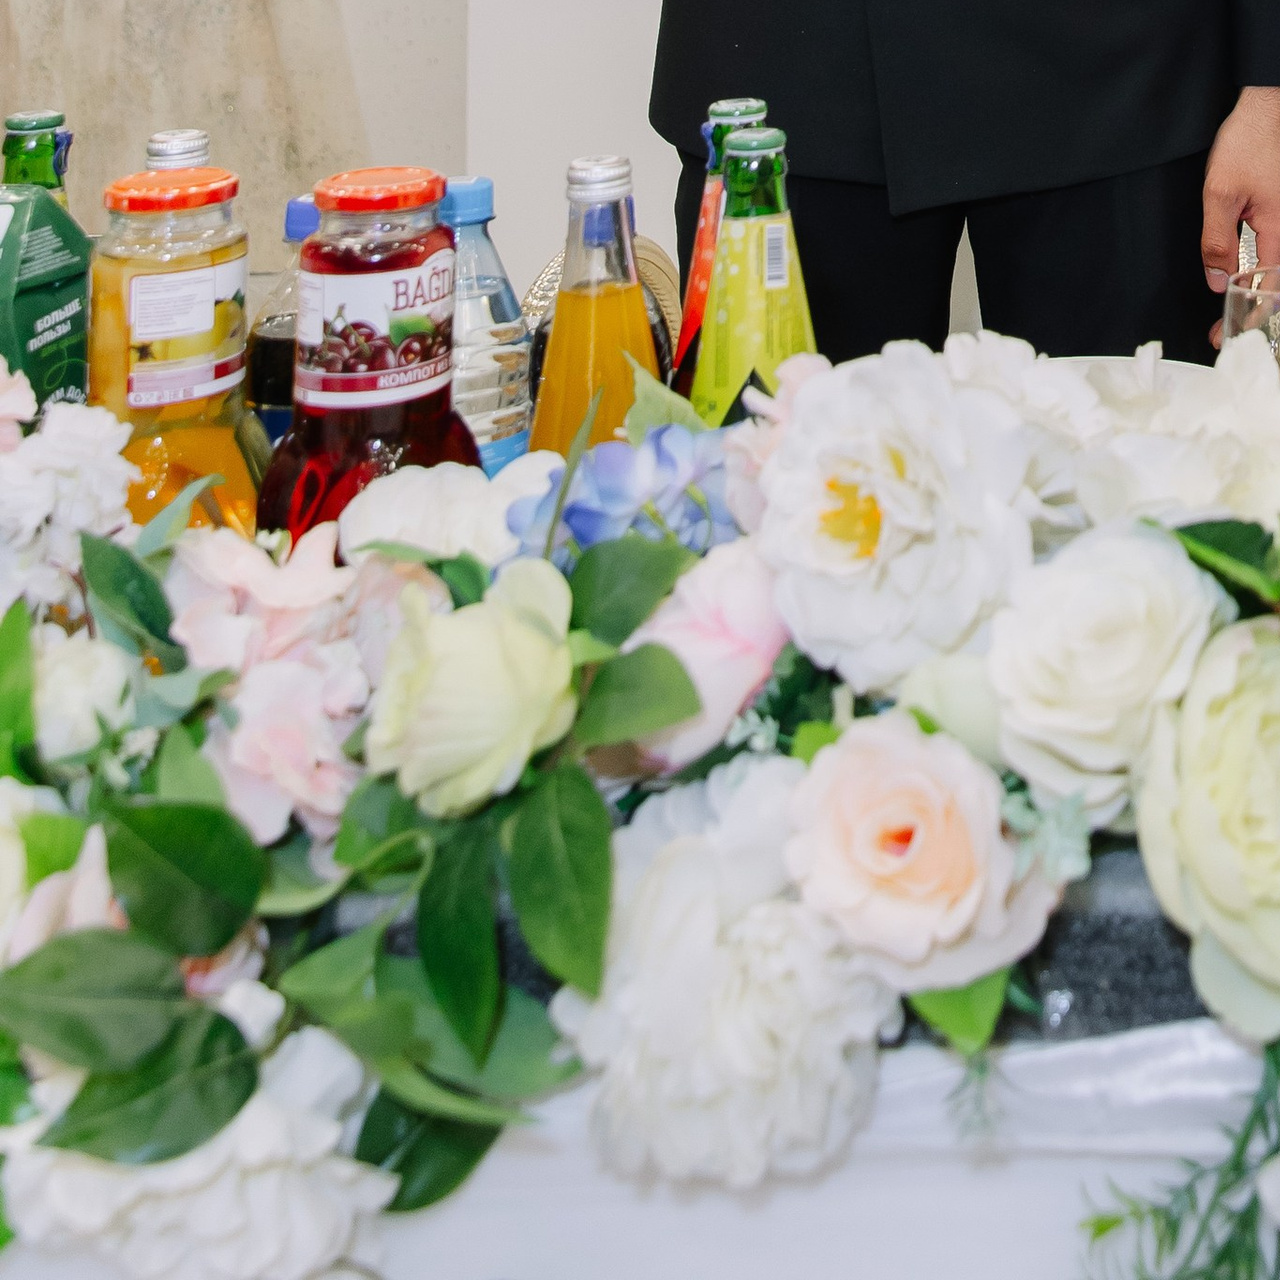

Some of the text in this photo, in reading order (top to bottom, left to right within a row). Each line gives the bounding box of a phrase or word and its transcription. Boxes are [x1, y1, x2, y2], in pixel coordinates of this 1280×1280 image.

[35, 298, 82, 332] БОЛЬШЕ
[28, 320, 71, 351] ПОЛЬЗЫ
[378, 364, 436, 388] КОМПОТ
